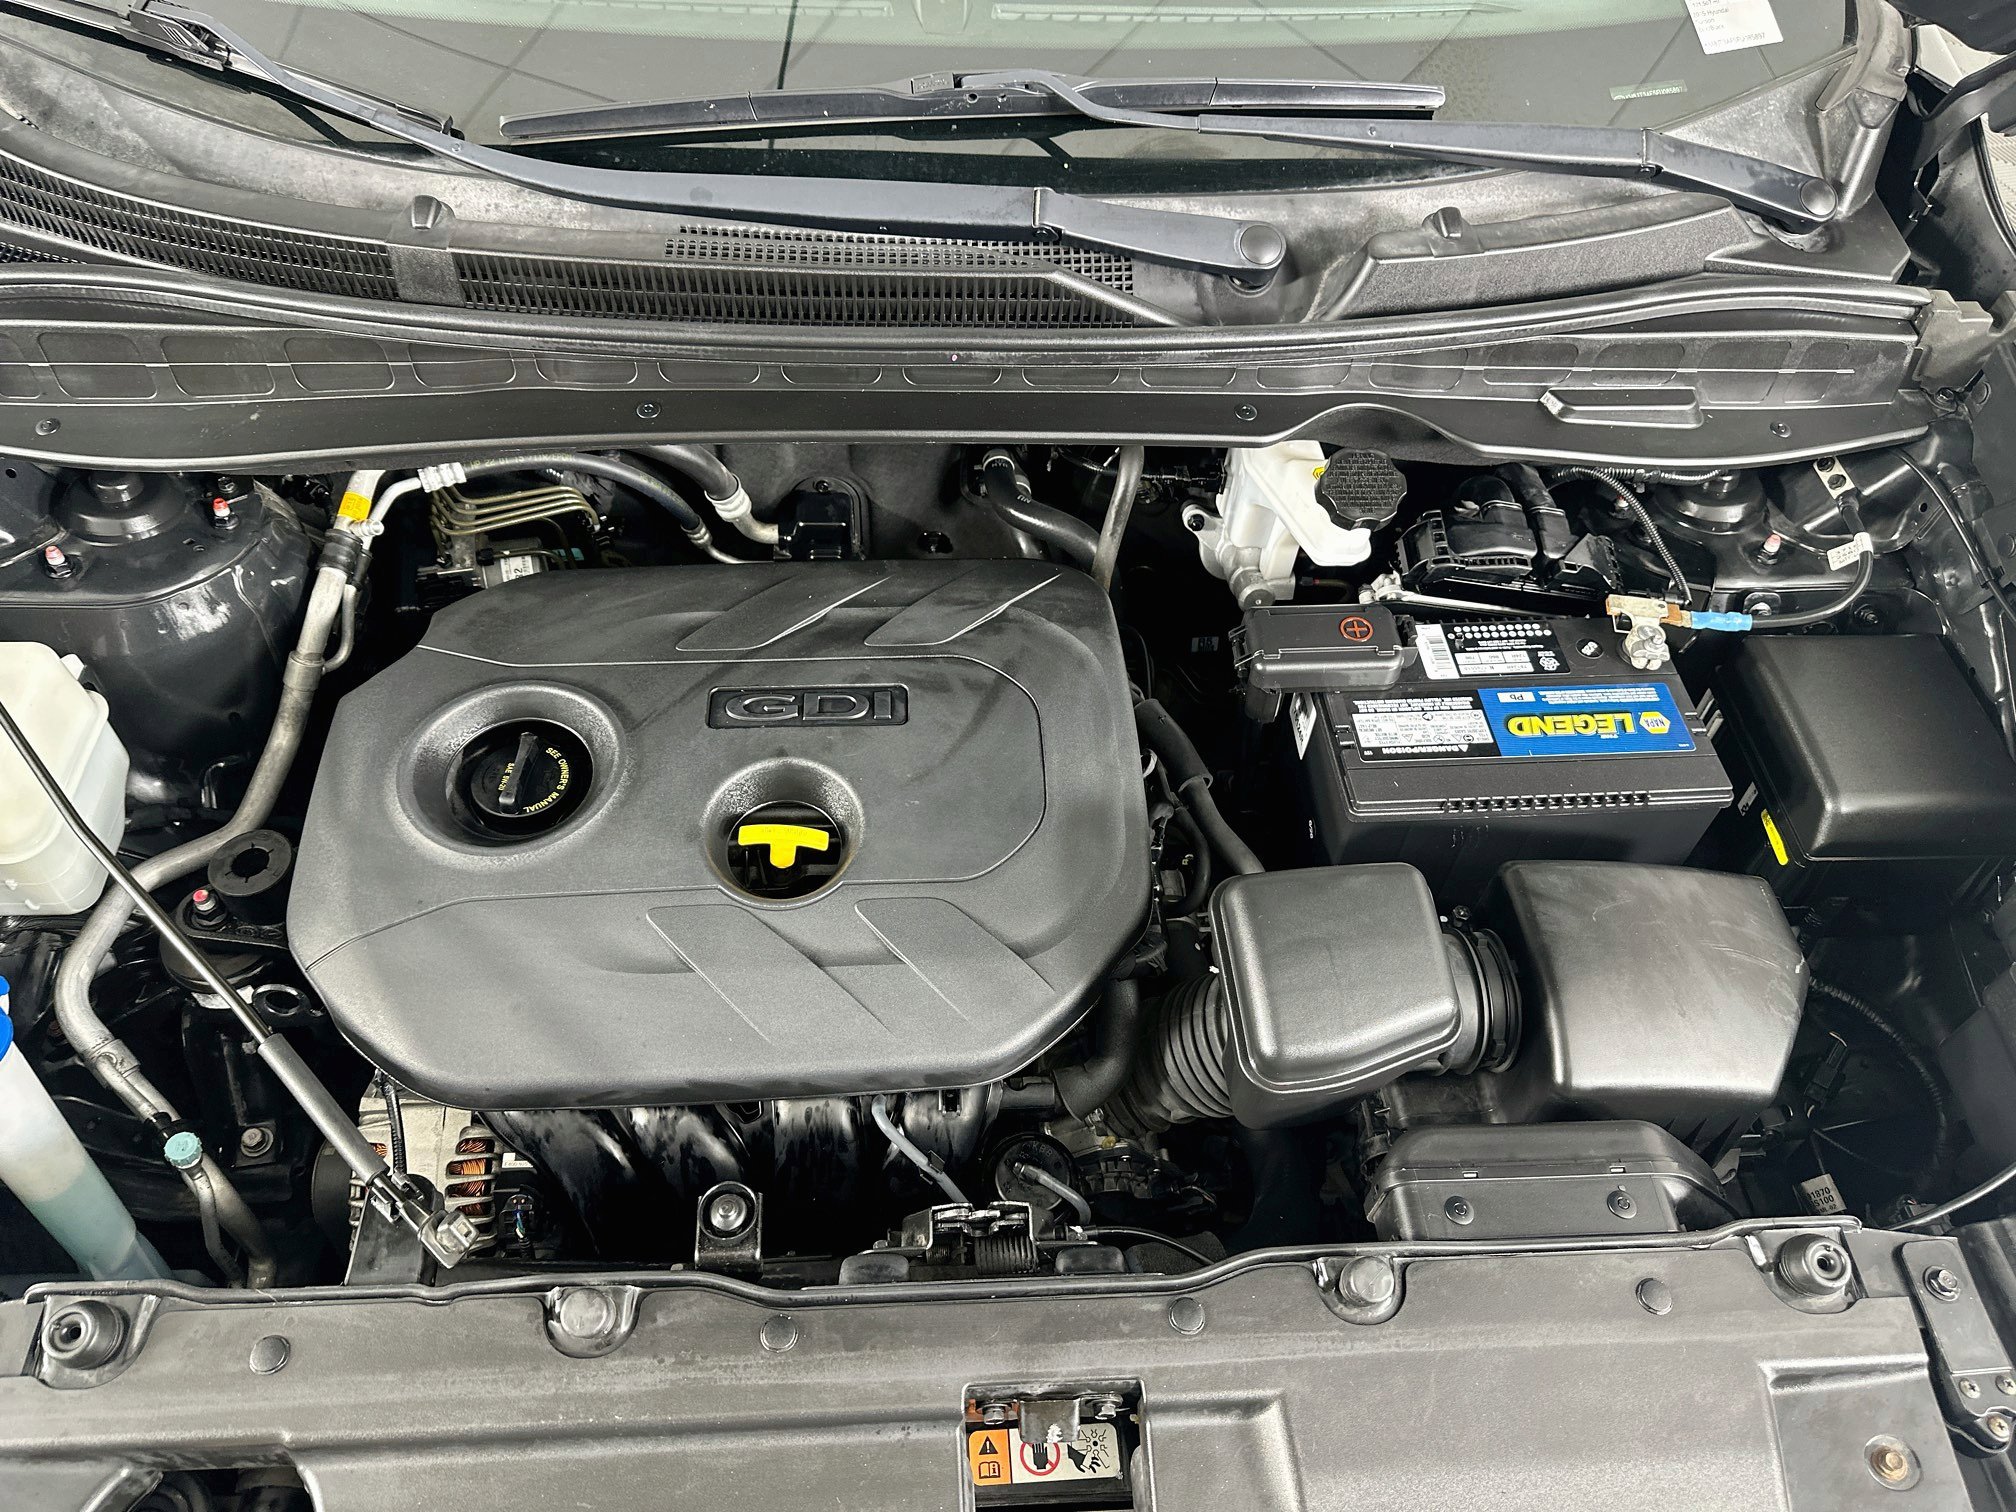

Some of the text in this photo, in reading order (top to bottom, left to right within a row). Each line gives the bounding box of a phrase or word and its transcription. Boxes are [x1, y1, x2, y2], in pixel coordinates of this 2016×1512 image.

[725, 691, 892, 722] GDI
[1507, 711, 1637, 738] LEGEND
[1644, 718, 1667, 728] NAPA
[522, 747, 570, 813] SEE OWNER'S MANUAL
[1811, 1194, 1835, 1207] S100
